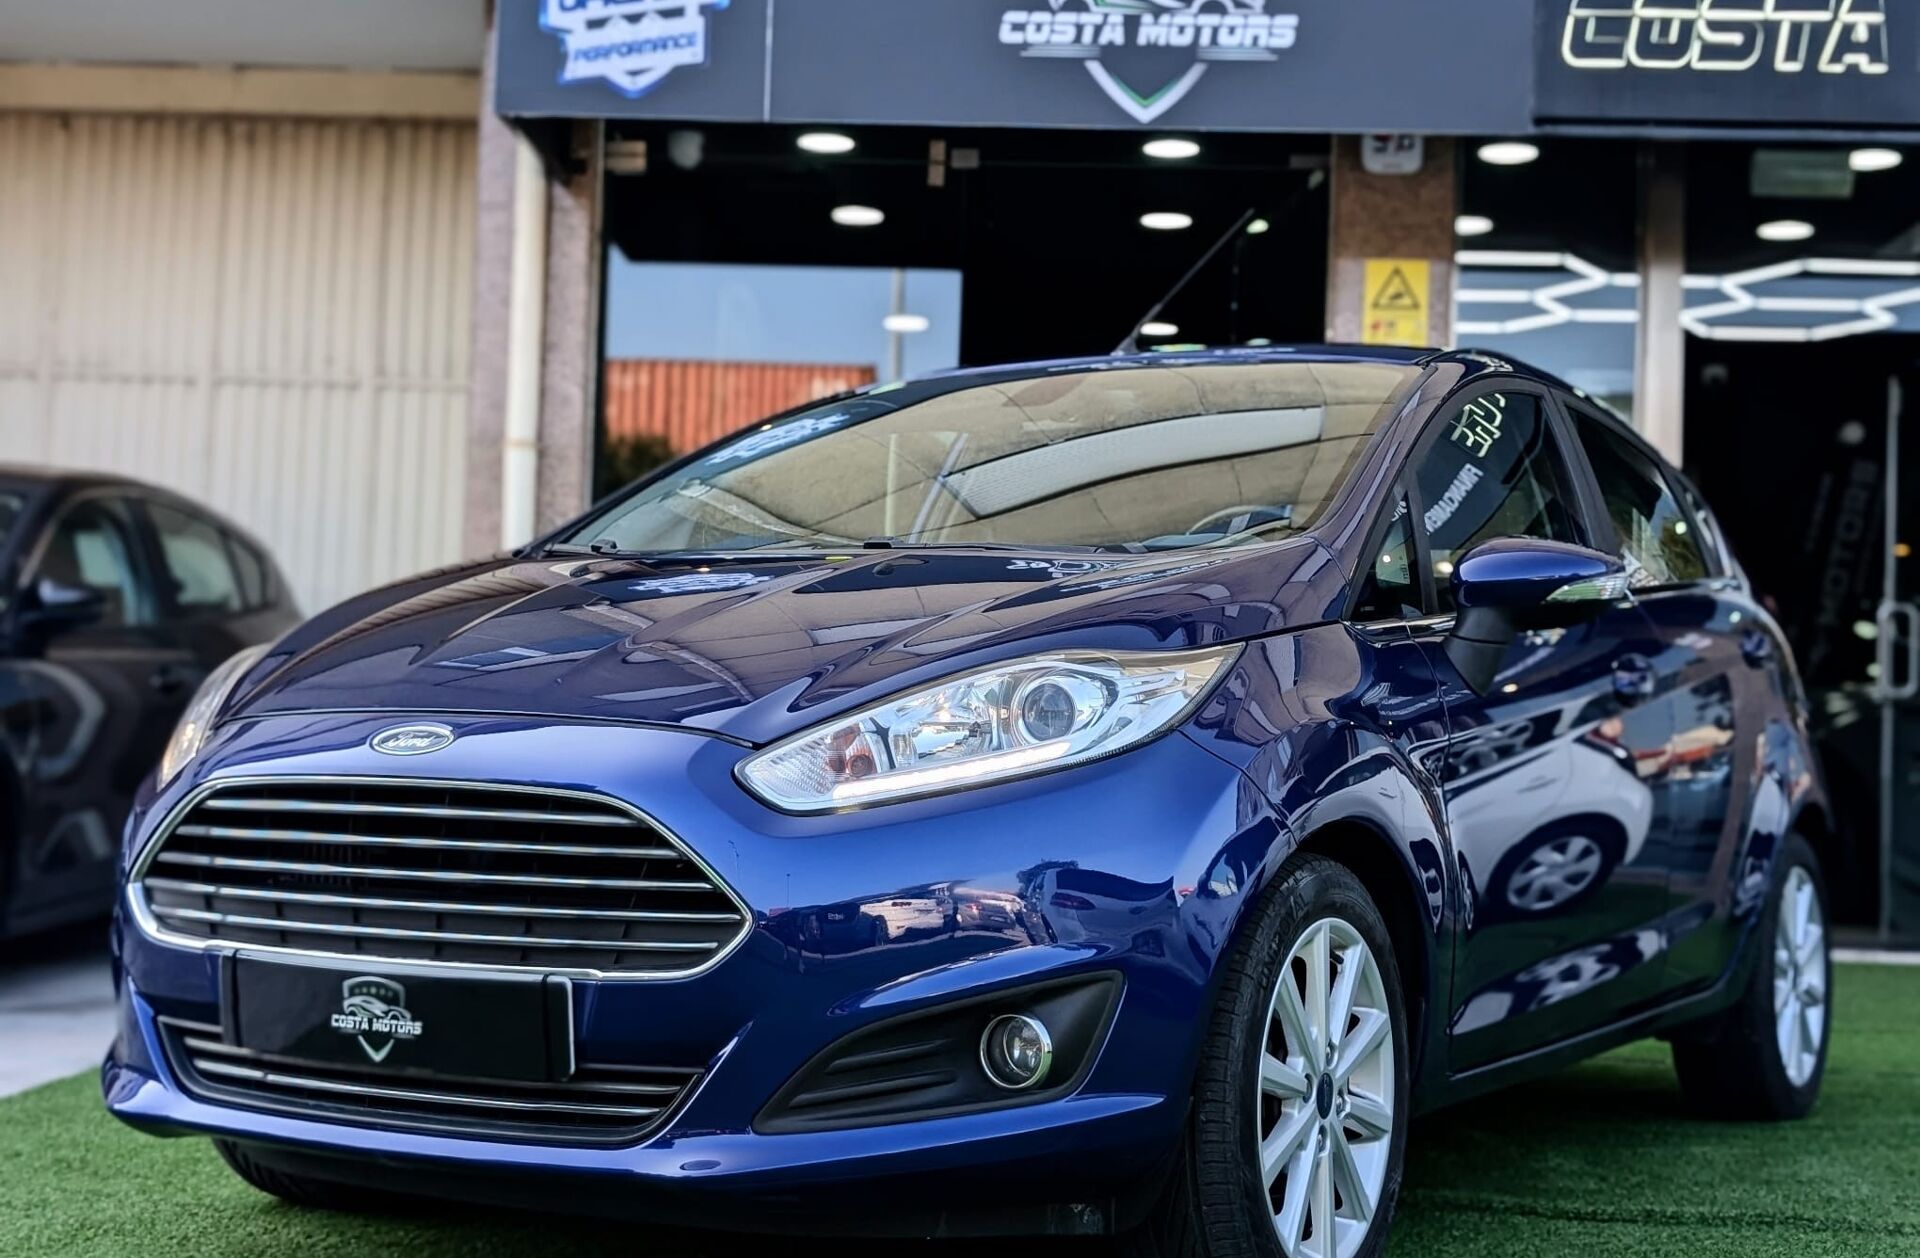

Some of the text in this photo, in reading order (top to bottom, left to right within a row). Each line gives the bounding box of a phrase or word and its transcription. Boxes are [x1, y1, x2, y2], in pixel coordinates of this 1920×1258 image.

[999, 10, 1299, 49] COSTA MOTORS
[1561, 0, 1889, 74] COSTA
[575, 33, 697, 61] PERFORMANCE
[381, 731, 435, 748] Ford
[331, 1013, 423, 1035] COSTA MOTORS
